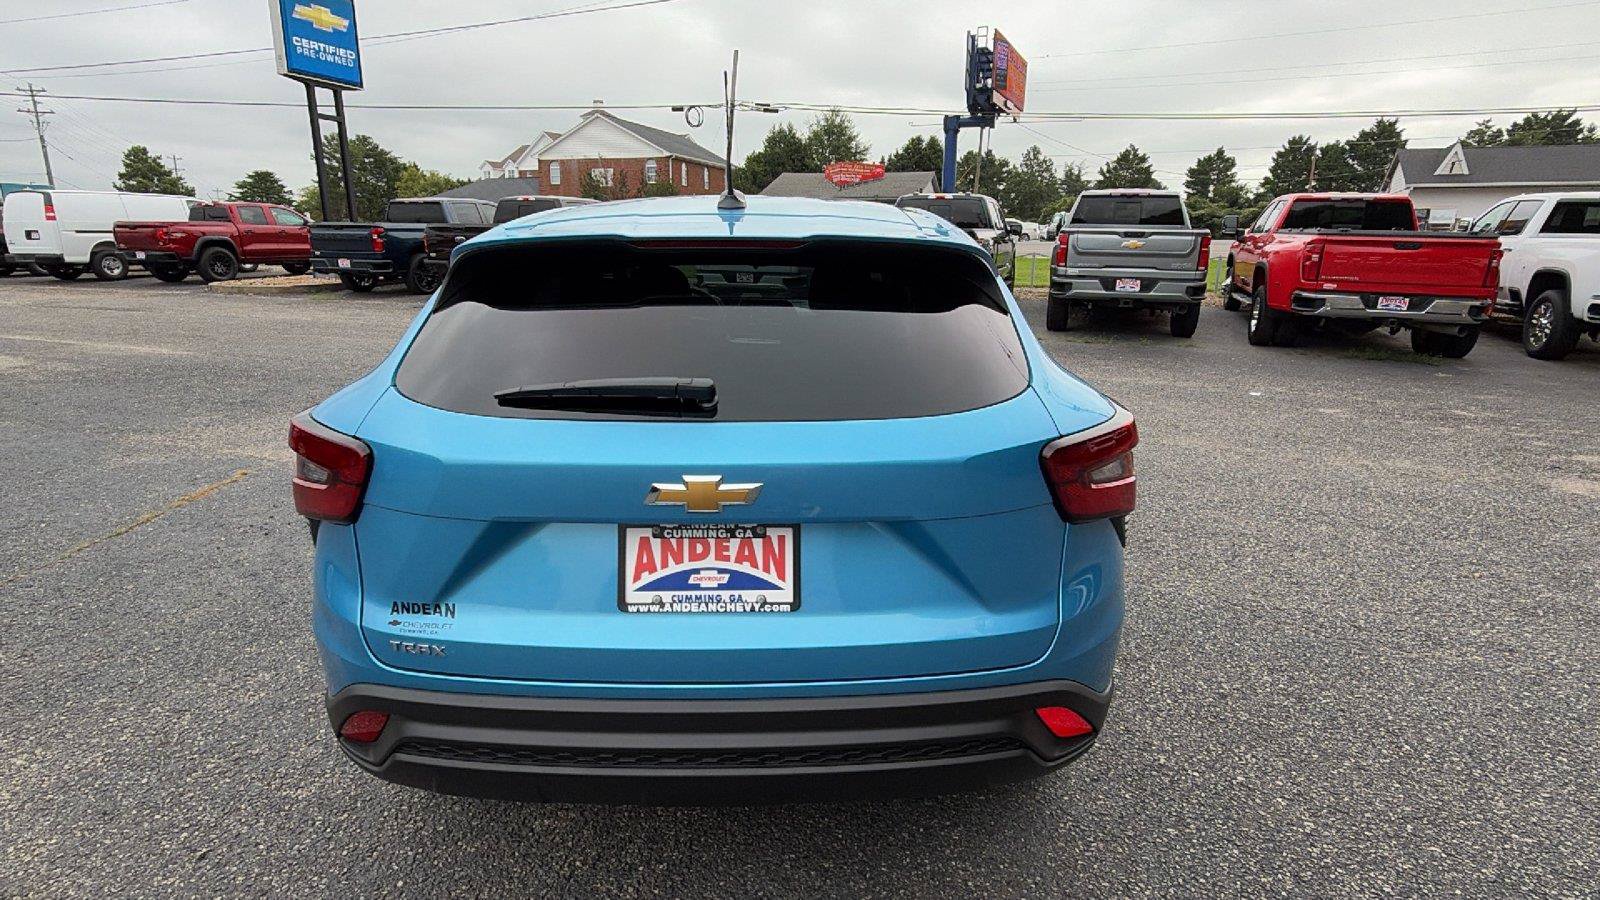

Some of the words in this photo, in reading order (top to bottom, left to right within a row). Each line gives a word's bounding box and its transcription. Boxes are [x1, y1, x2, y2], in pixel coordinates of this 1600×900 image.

[292, 36, 355, 59] CERTIFIED
[296, 46, 354, 67] PRE-OWNED
[663, 529, 731, 538] CUMMING,
[735, 529, 753, 538] GA
[632, 534, 786, 583] ANDEAN
[390, 601, 456, 619] ANDEAN
[628, 602, 791, 613] www.ANDEANCHEVY.com
[402, 621, 454, 630] CHEVROLET
